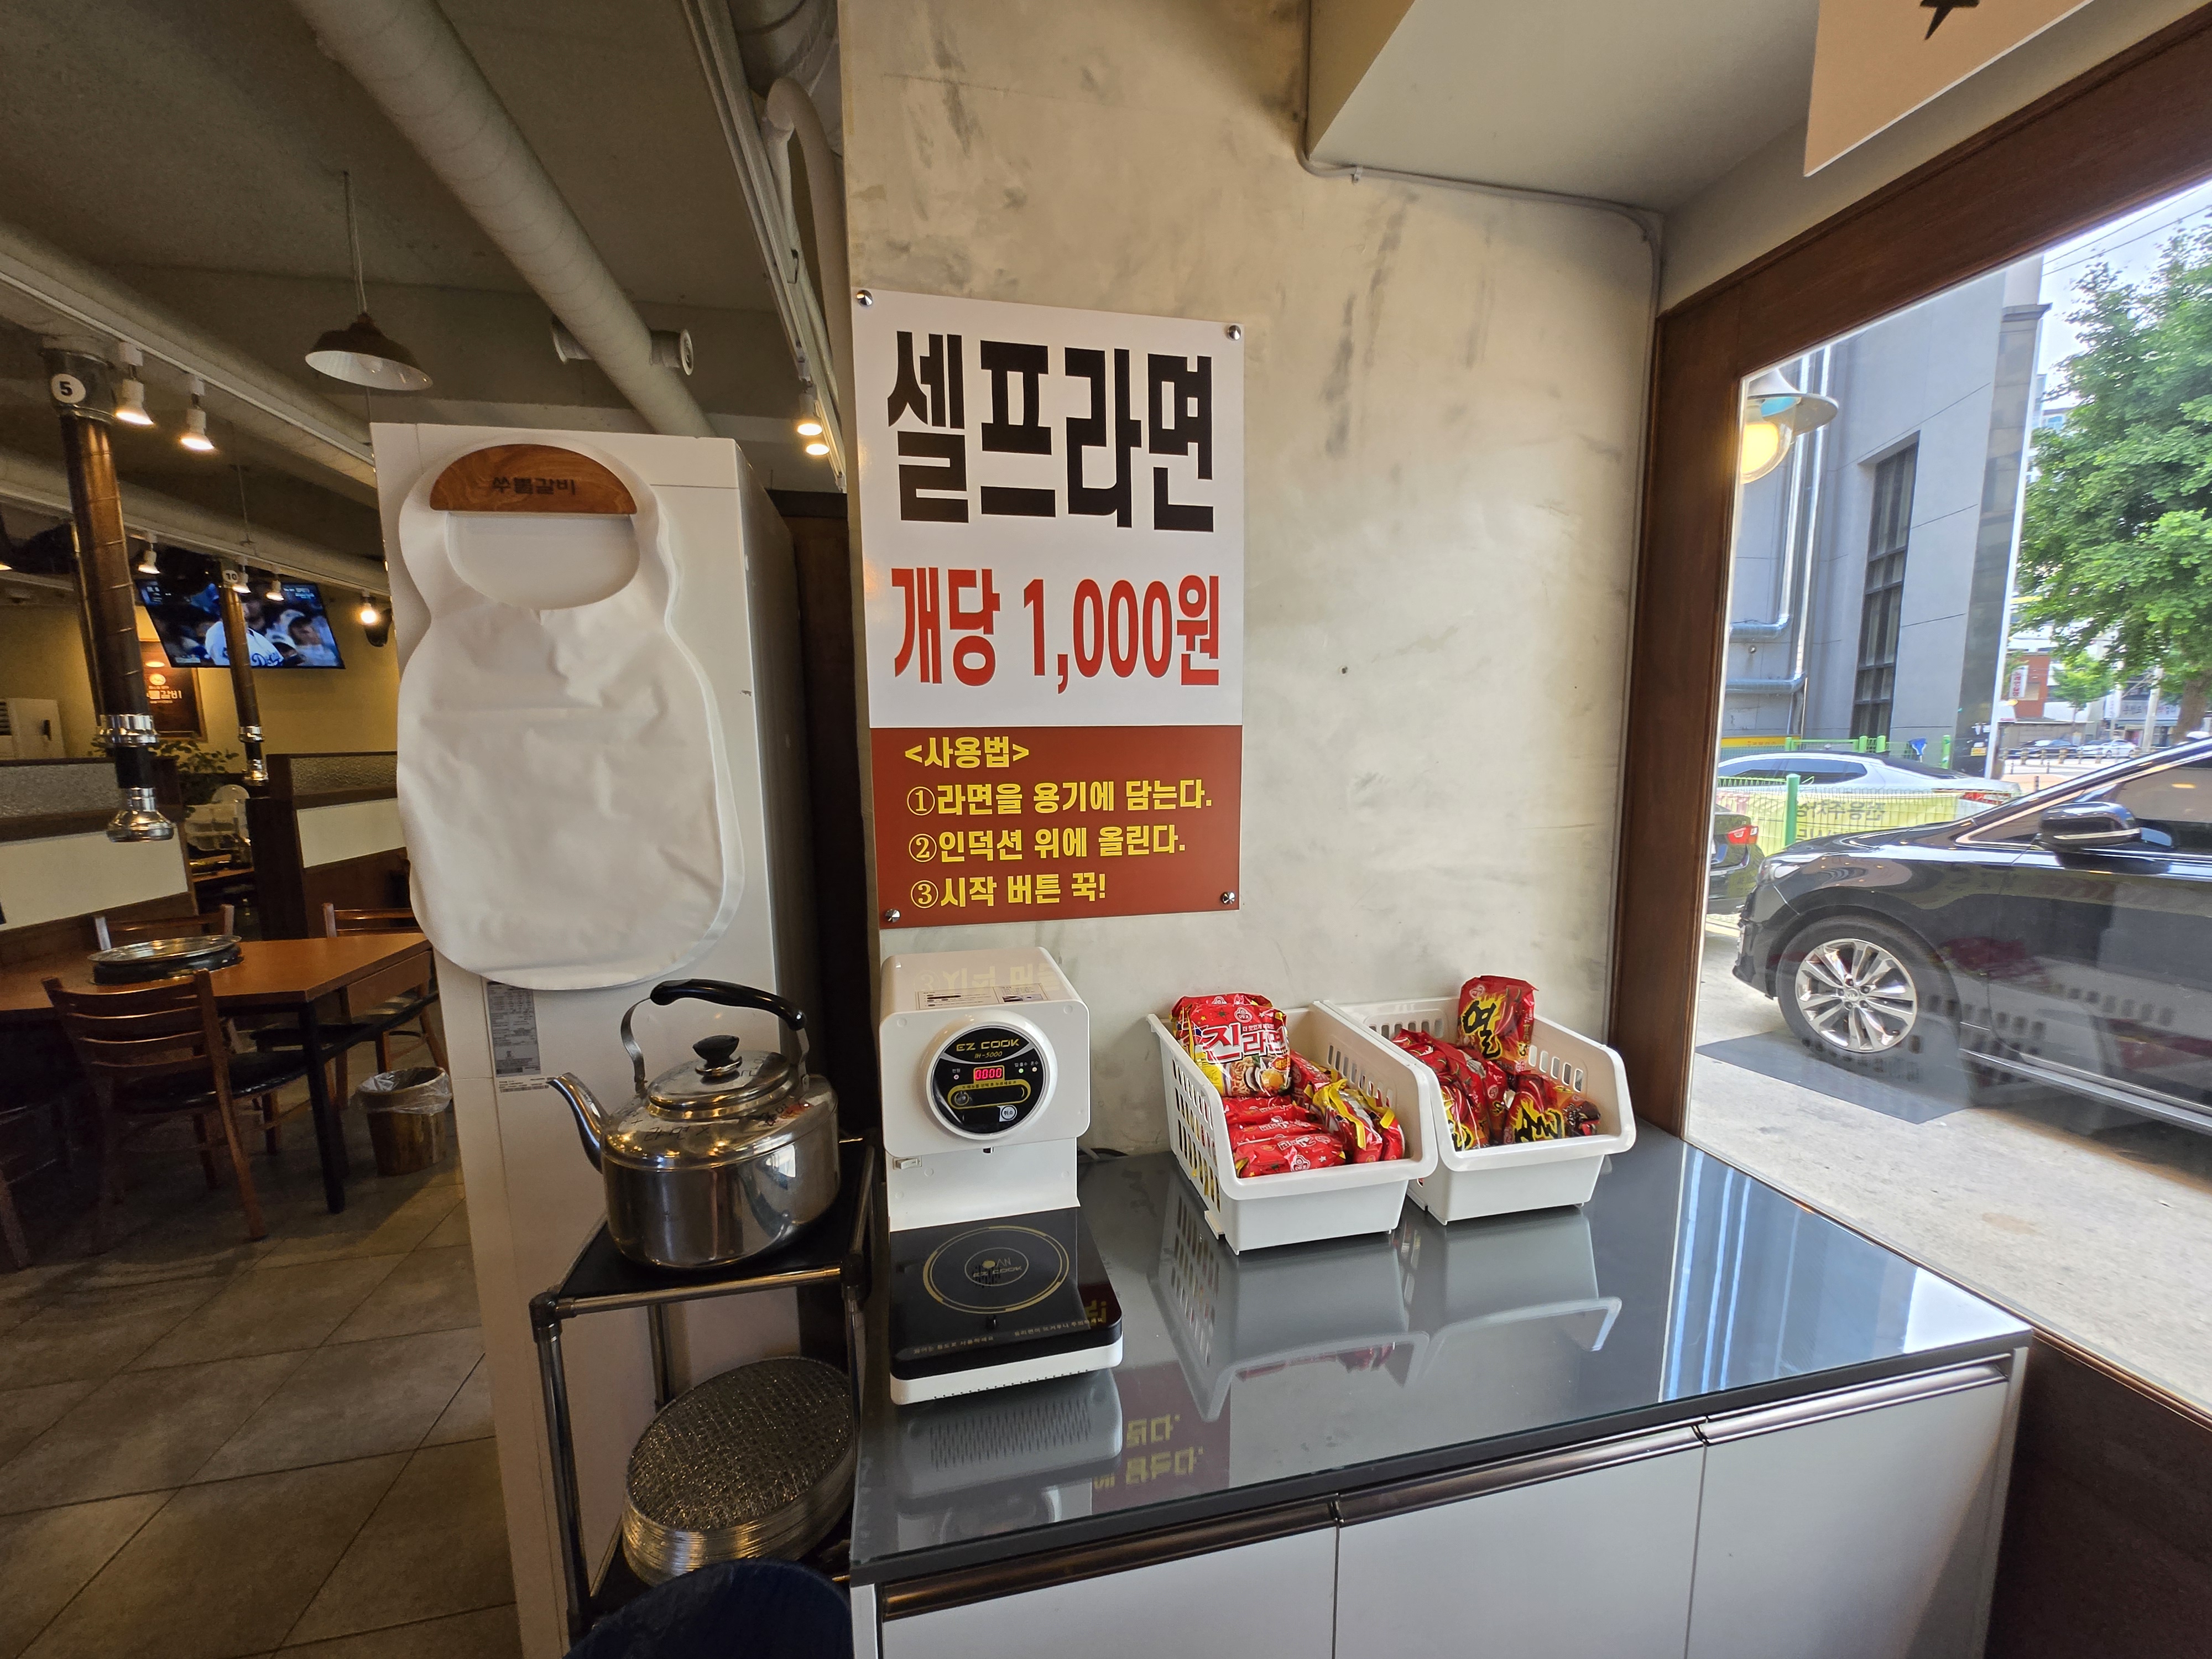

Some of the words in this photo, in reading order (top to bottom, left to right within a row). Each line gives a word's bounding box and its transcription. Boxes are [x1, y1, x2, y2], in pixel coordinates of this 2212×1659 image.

[59, 381, 73, 396] 5
[888, 331, 1214, 533] 셀프라면
[891, 567, 1000, 686] 개당
[1024, 575, 1219, 694] 1,000원
[905, 736, 1029, 769] <사용법>
[1034, 781, 1115, 813] 용기에
[1126, 779, 1212, 811] 담는다.
[1034, 827, 1087, 859] 위에
[1098, 824, 1186, 857] 올린다.
[1007, 873, 1061, 905] 버튼
[1071, 872, 1106, 902] 꾹!
[956, 1043, 975, 1051] EZ
[981, 1039, 1020, 1050] COOK
[975, 1068, 1002, 1080] 0000
